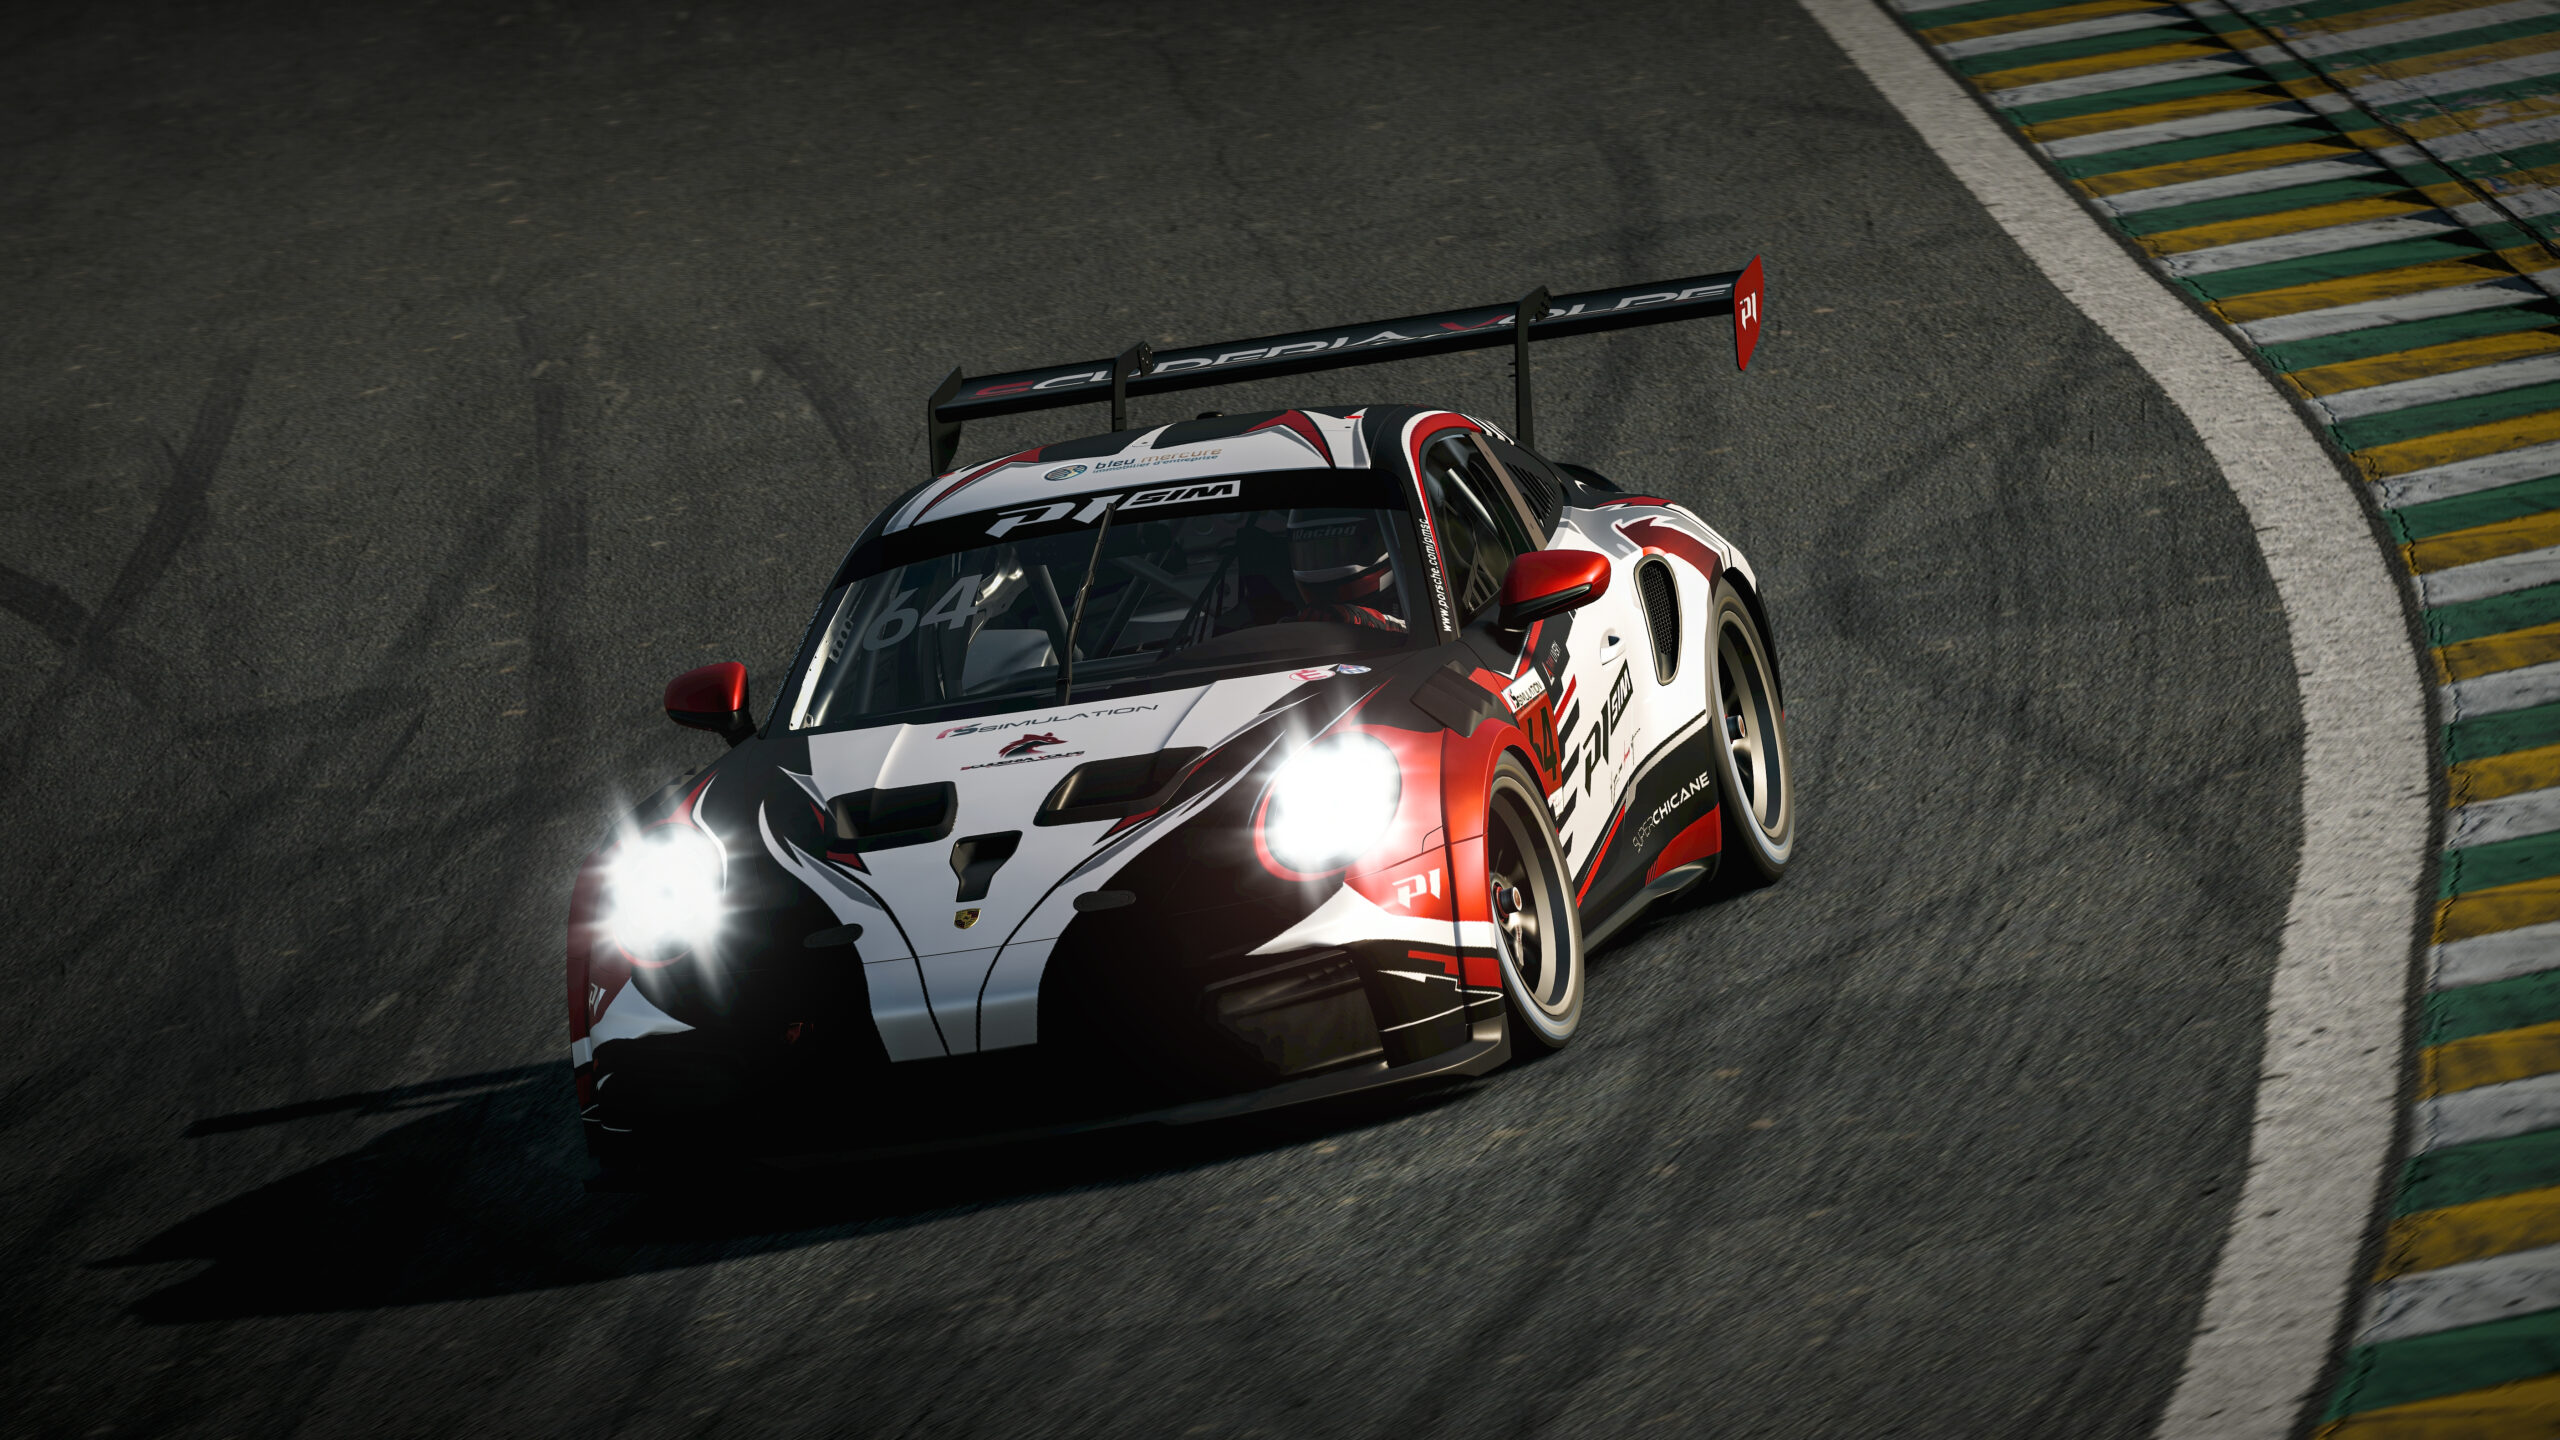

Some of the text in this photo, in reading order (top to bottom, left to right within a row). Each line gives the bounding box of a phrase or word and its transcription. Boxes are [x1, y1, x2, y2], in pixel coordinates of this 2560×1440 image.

[1095, 449, 1222, 470] bleu mercure
[1129, 484, 1233, 507] SIM
[1419, 518, 1453, 632] www.porsche.com/pmsc
[862, 572, 982, 652] 64
